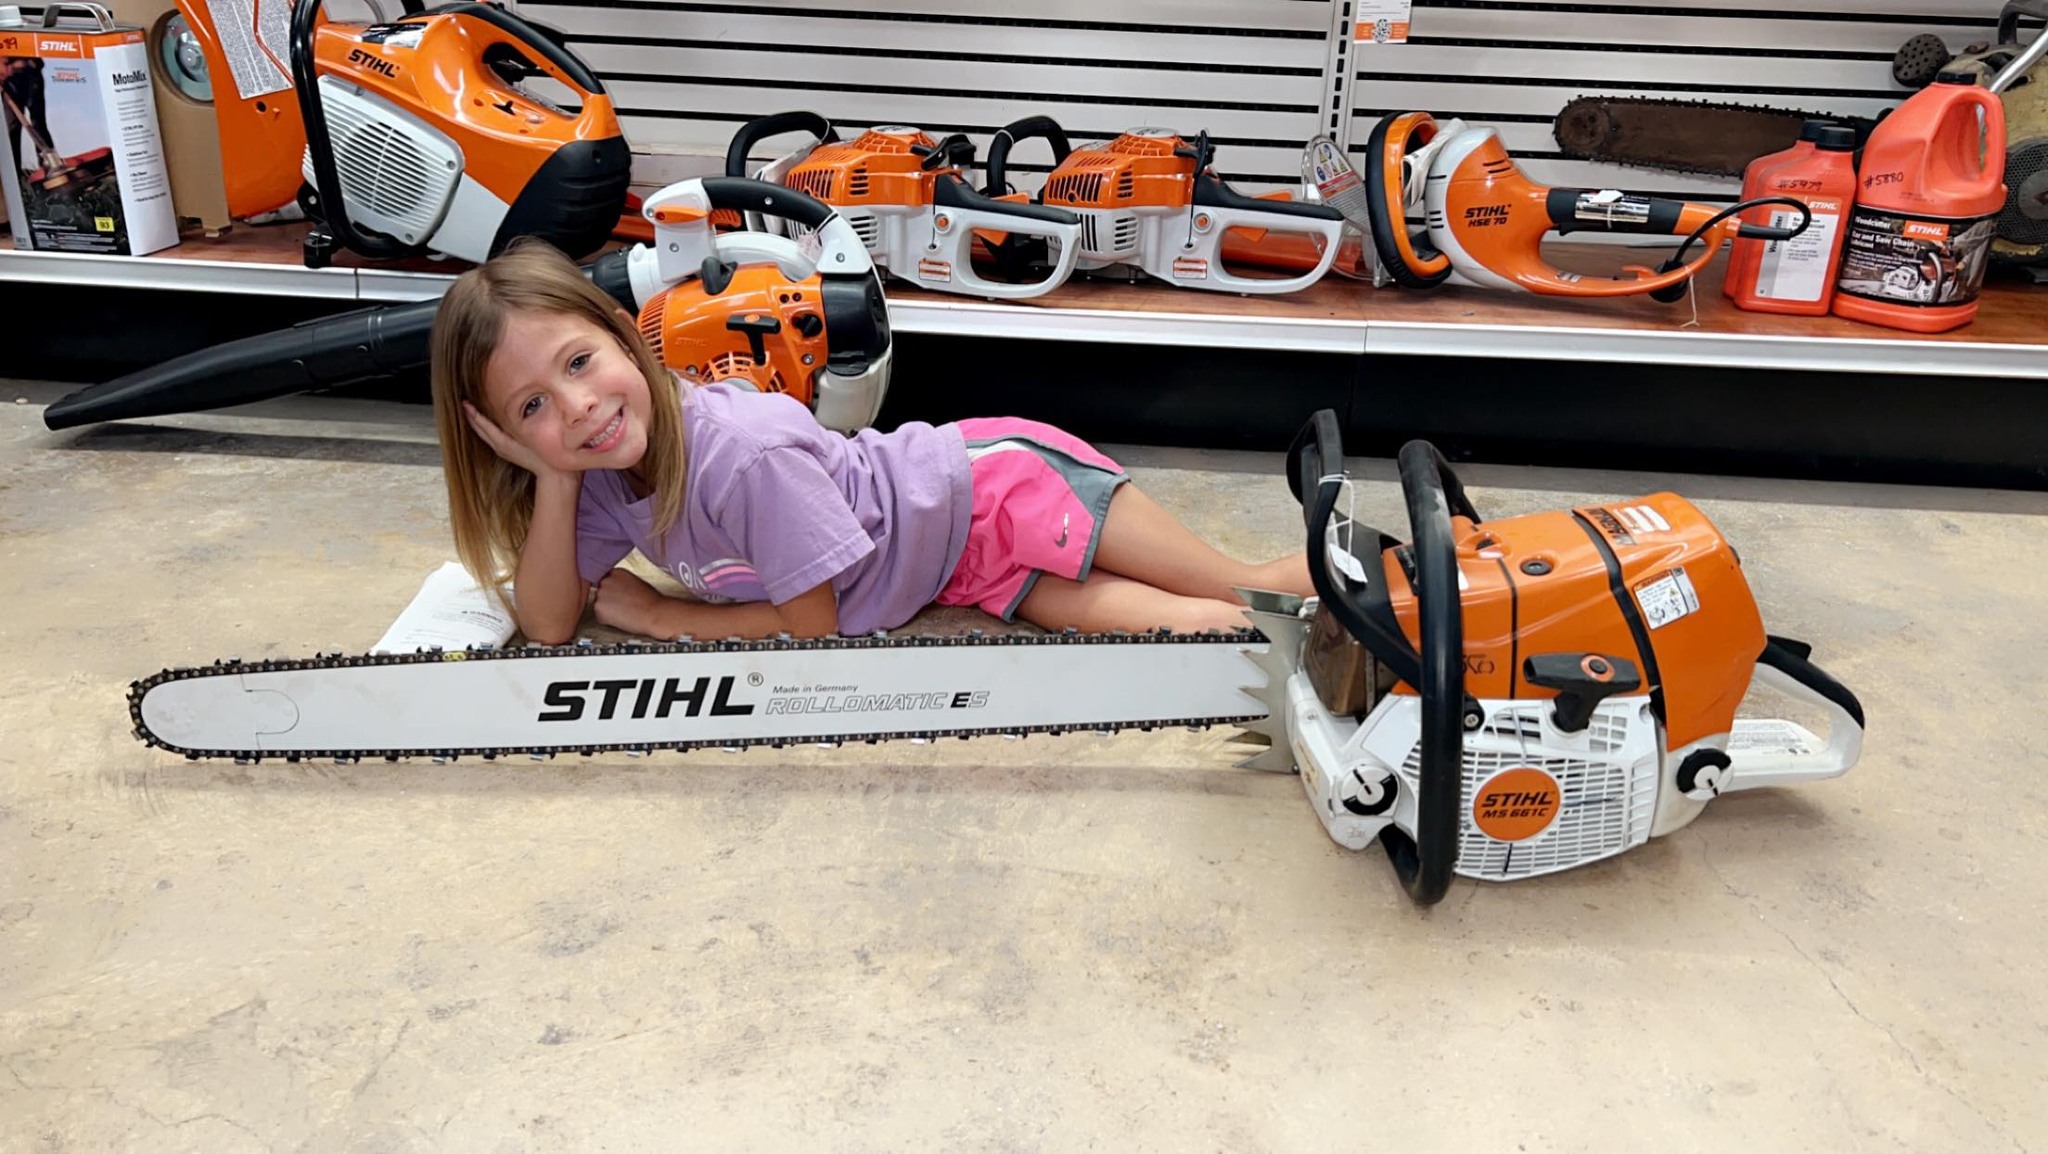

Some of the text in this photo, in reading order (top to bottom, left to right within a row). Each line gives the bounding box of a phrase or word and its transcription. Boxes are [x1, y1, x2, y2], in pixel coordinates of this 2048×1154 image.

[40, 41, 77, 52] STIHL
[348, 49, 396, 78] STIHL
[112, 69, 148, 86] MotoMix
[1863, 172, 1904, 190] #5880
[1464, 205, 1509, 218] STIHL
[1808, 201, 1837, 210] STIHL
[1468, 216, 1508, 228] HSE 70
[1906, 224, 1944, 237] STIHL
[1861, 232, 1875, 242] and
[1875, 235, 1891, 245] Saw
[1892, 238, 1915, 248] Chain
[772, 684, 859, 695] Made in Germany
[537, 676, 755, 722] STIHL
[765, 691, 990, 715] ROLLOMATIC ES
[1481, 791, 1553, 808] STIHL
[1482, 807, 1549, 819] MS 661C
